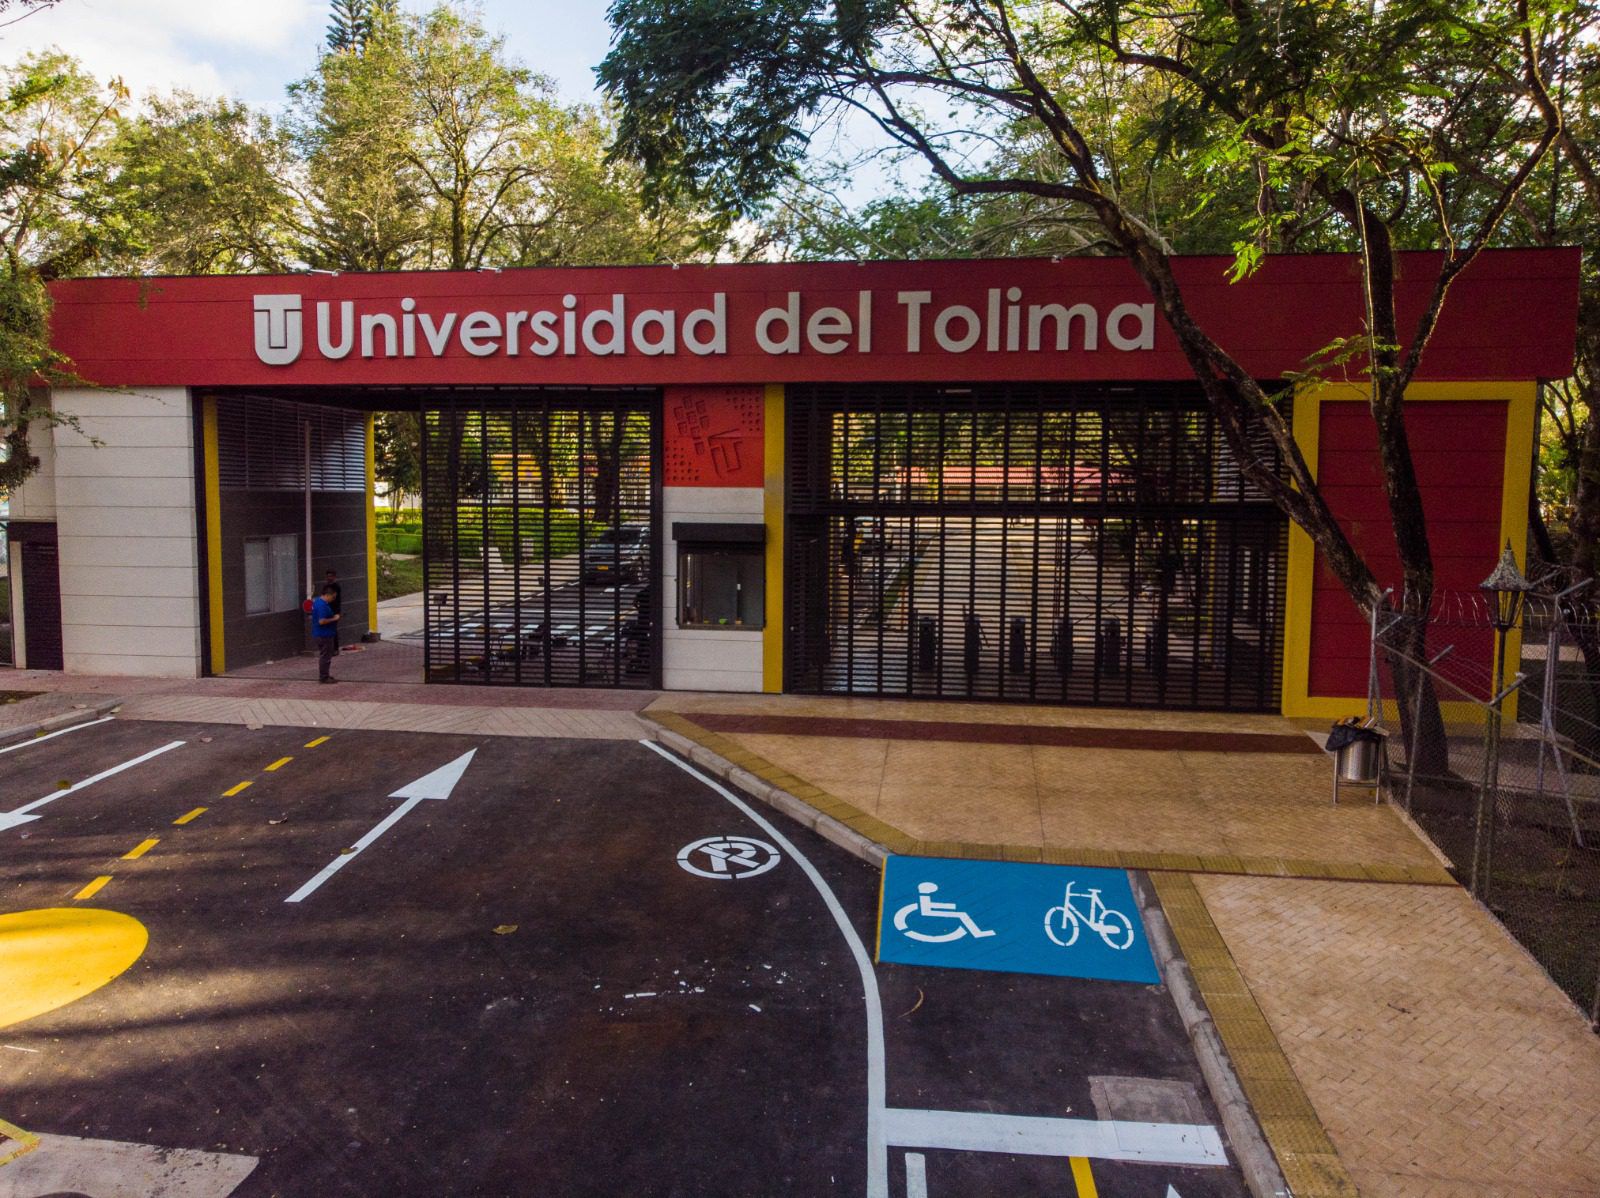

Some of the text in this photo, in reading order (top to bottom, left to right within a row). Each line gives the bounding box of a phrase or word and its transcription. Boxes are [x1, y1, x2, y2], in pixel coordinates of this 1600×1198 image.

[317, 287, 1155, 359] Universidad del Tolima
